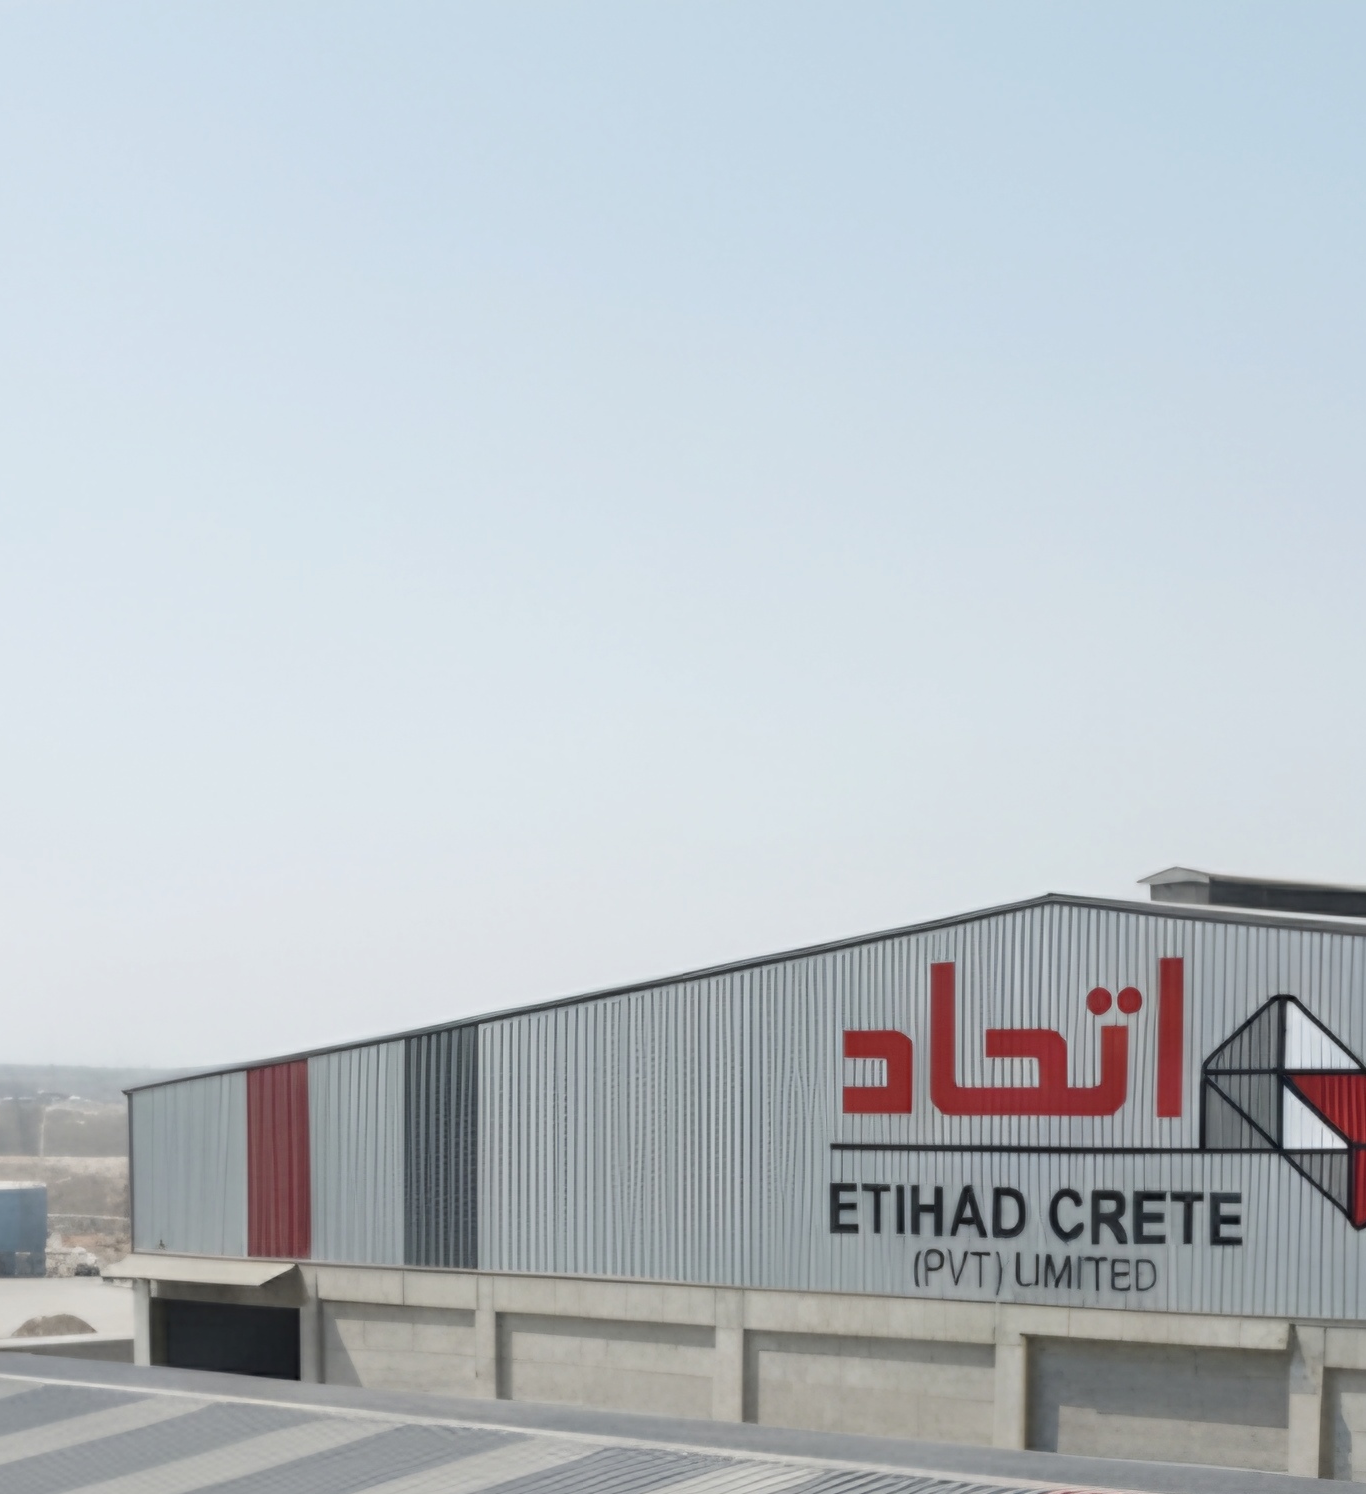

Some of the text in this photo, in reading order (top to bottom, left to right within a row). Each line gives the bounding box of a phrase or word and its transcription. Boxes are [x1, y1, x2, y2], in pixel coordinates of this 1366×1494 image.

[842, 956, 1184, 1118] اتحاد
[829, 1182, 1243, 1246] ETIHAD CRETE
[913, 1248, 1157, 1295] (PVT) LIMITED
